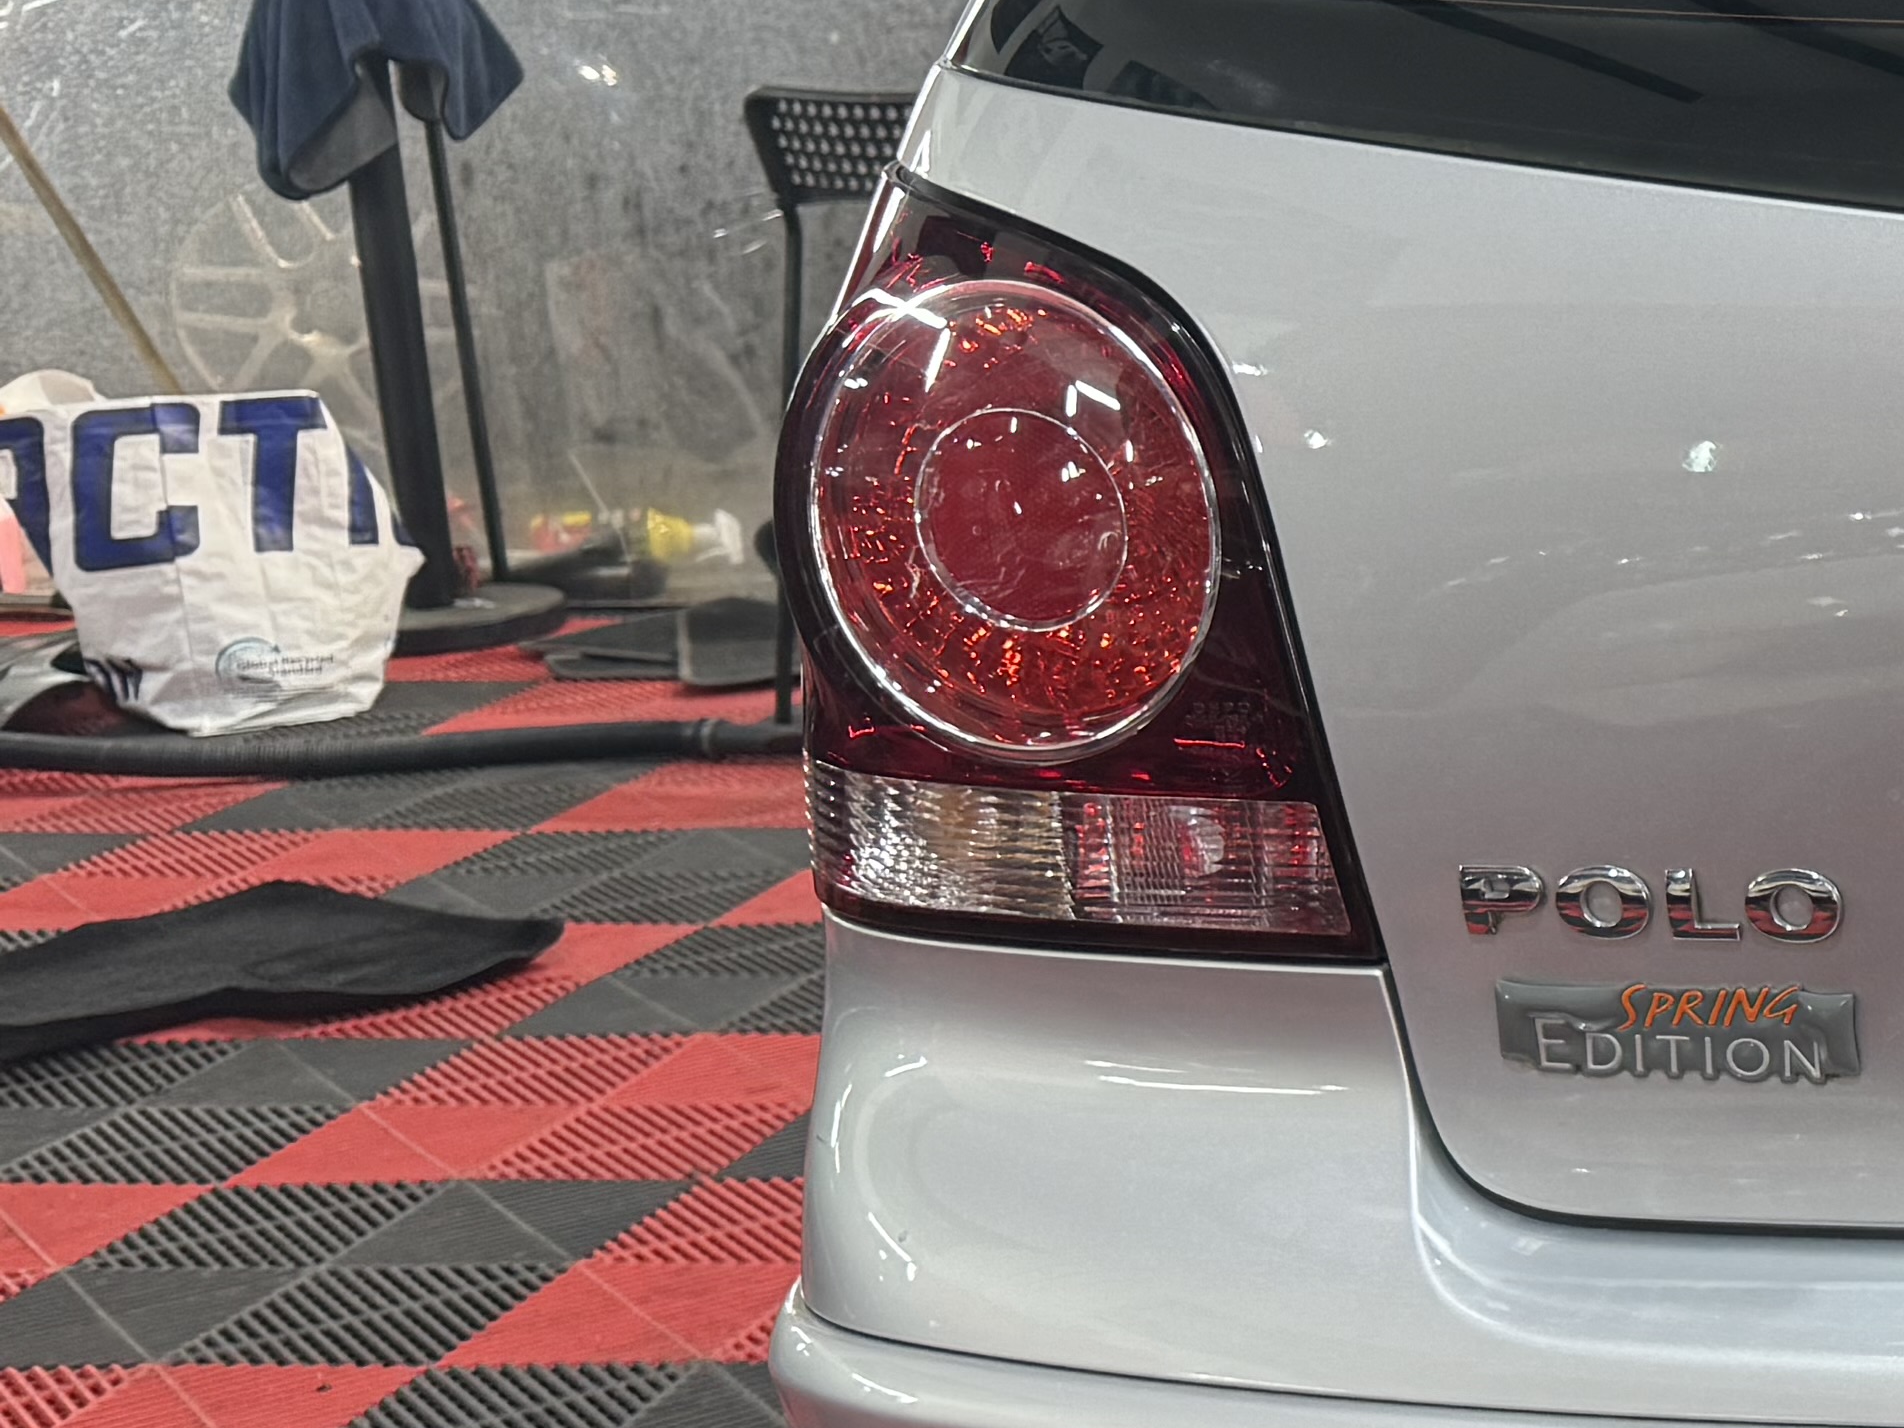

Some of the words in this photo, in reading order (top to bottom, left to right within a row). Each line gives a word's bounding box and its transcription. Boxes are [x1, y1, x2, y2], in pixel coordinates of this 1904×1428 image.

[1459, 864, 1844, 943] POLO
[1619, 984, 1801, 1031] SPRING
[1534, 1018, 1823, 1078] EDITION
